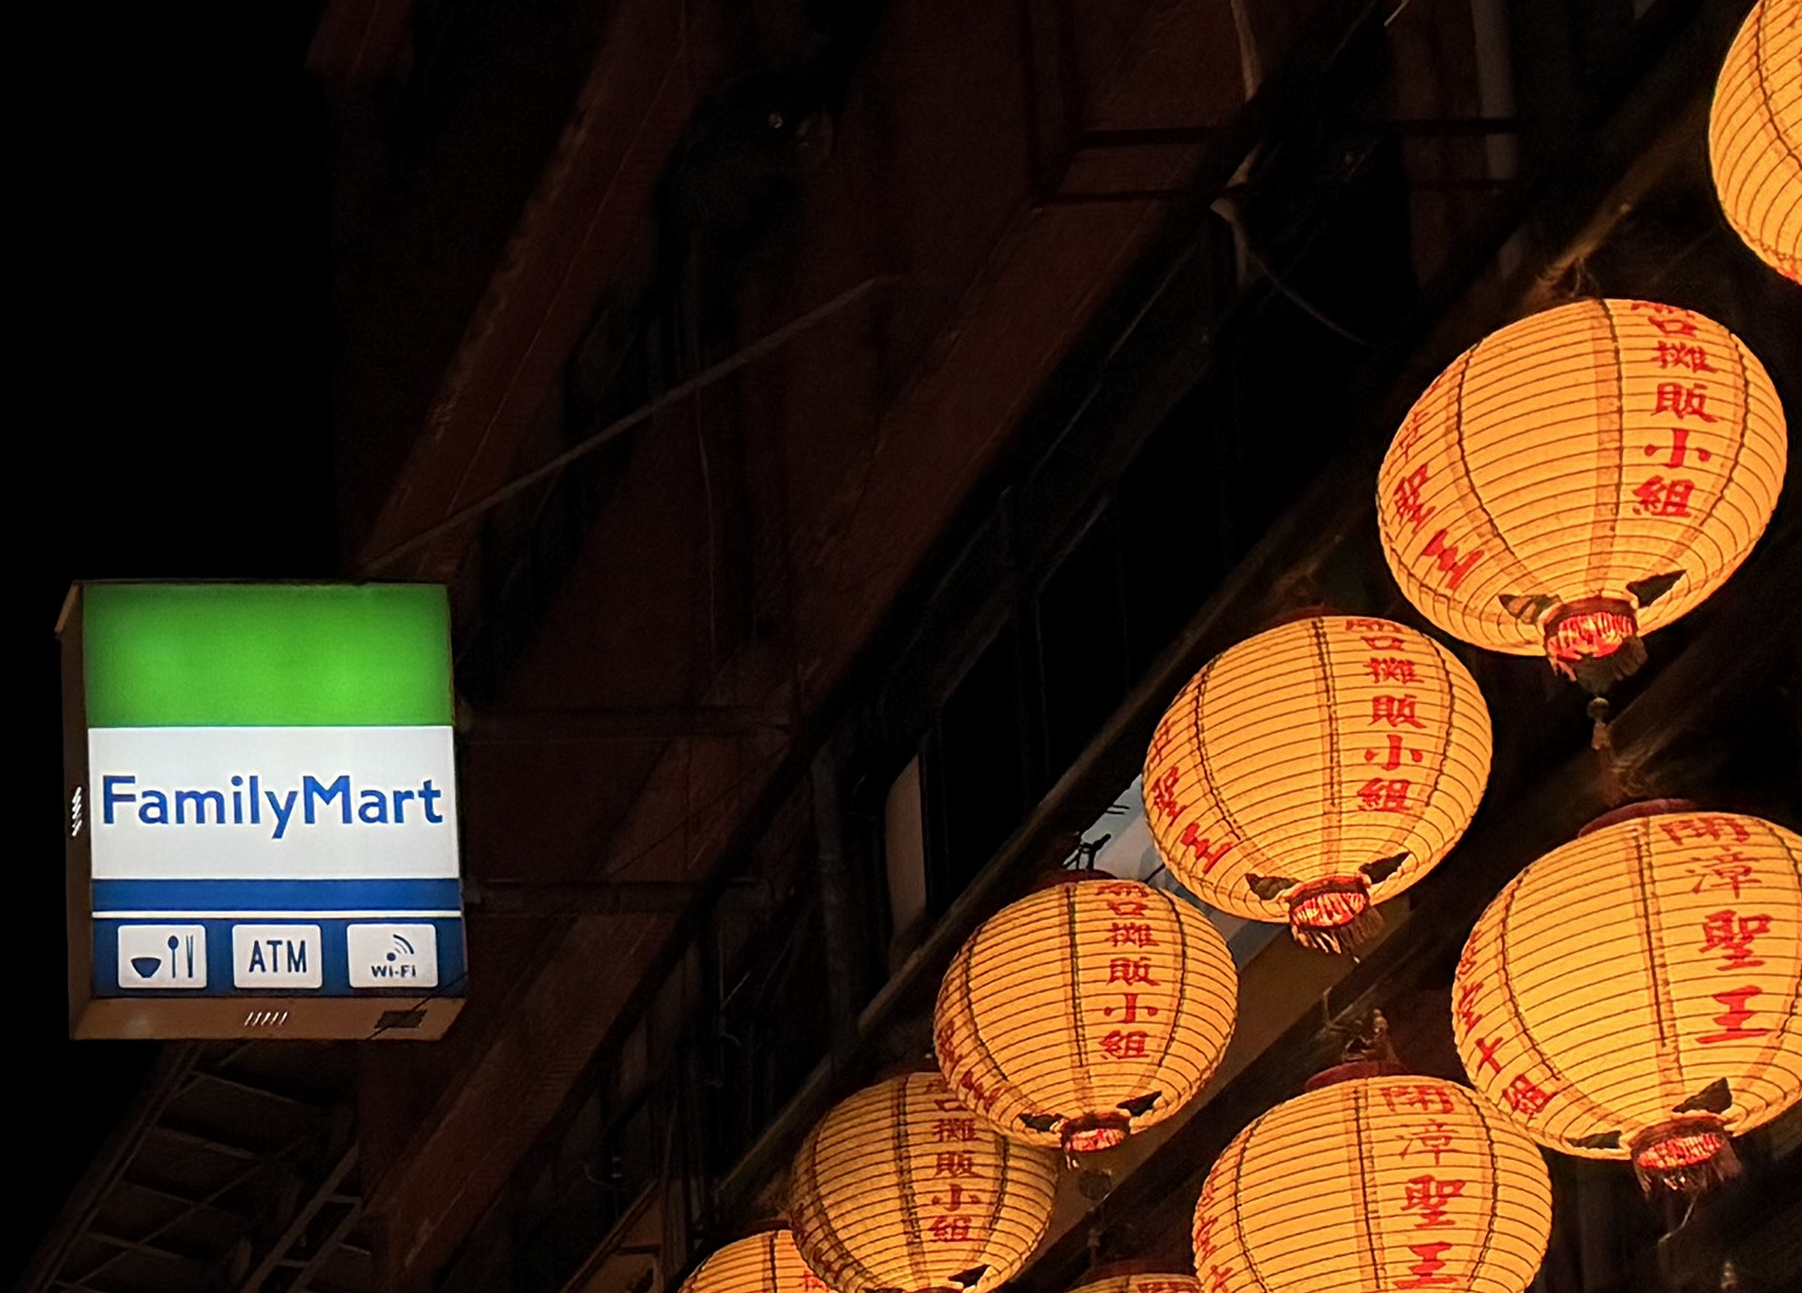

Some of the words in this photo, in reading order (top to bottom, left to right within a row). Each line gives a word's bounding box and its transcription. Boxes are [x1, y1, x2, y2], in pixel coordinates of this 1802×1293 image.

[101, 774, 444, 840] FamilyMart
[247, 939, 308, 975] ATM
[1660, 815, 1774, 1045] 開漳聖王
[370, 962, 418, 980] Wi-Fi
[1382, 1083, 1467, 1292] 開漳聖王
